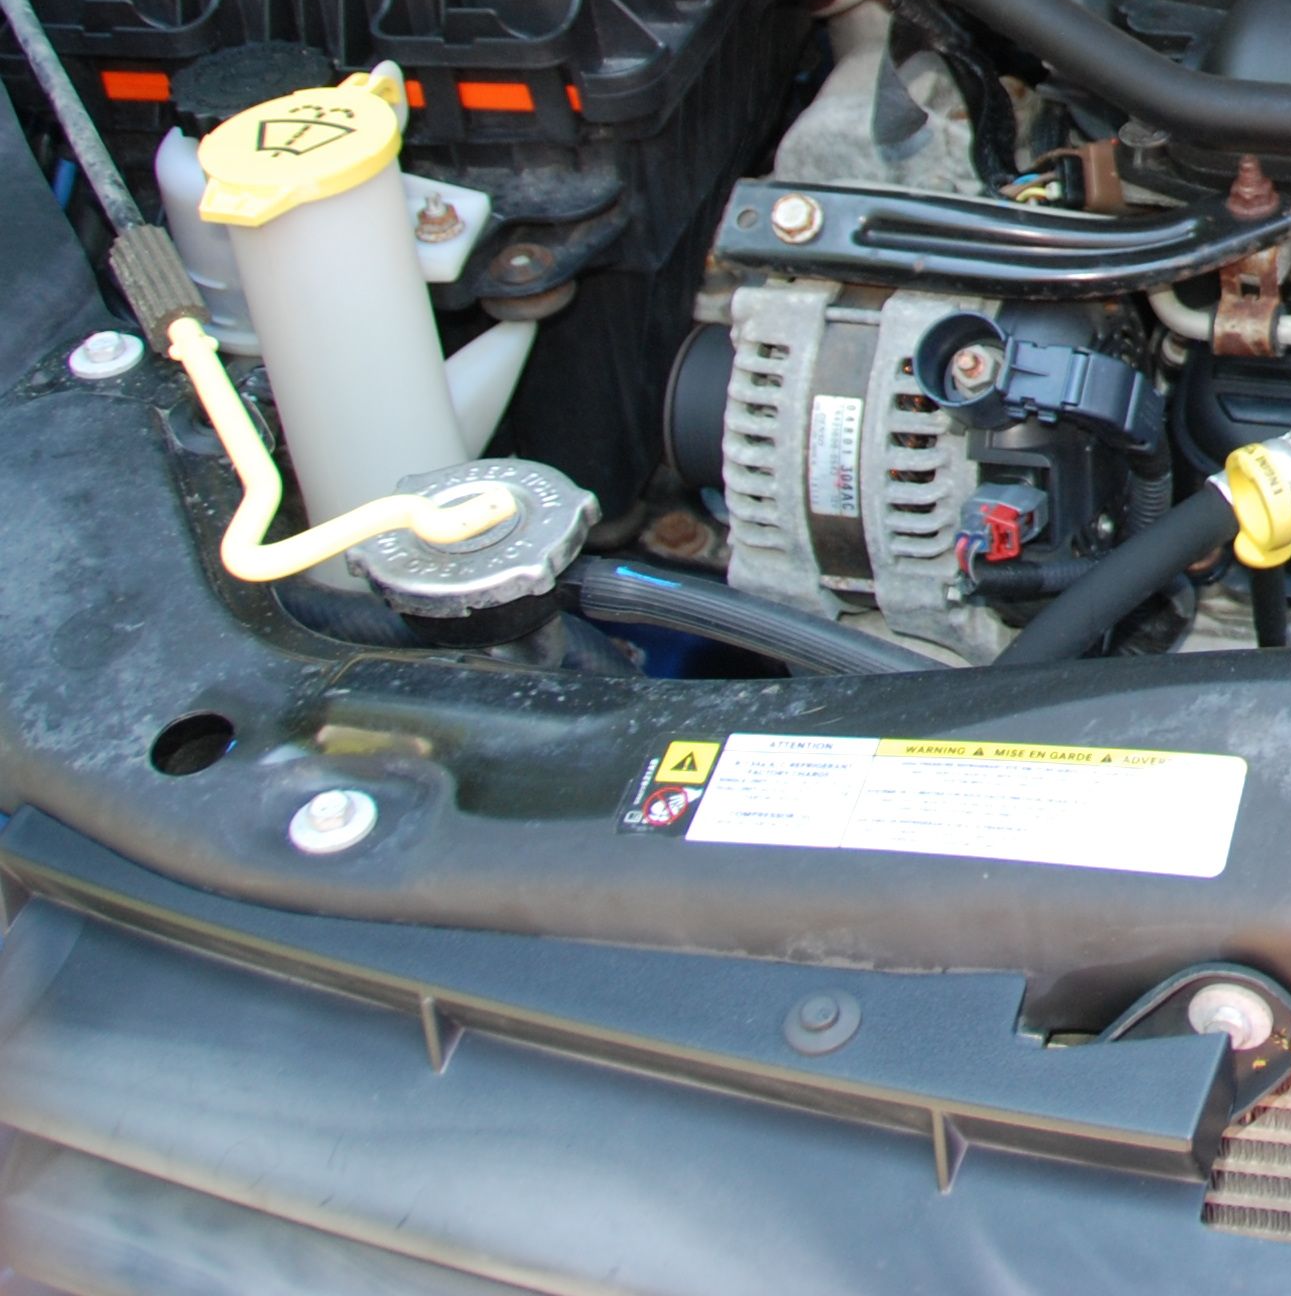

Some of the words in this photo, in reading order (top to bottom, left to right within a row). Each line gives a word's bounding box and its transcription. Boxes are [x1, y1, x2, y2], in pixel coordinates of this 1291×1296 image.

[769, 740, 834, 750] ATTENTION
[905, 744, 966, 755] WARNING
[994, 747, 1026, 759] MISE
[1029, 749, 1047, 759] EN
[1050, 751, 1093, 763] GARDE
